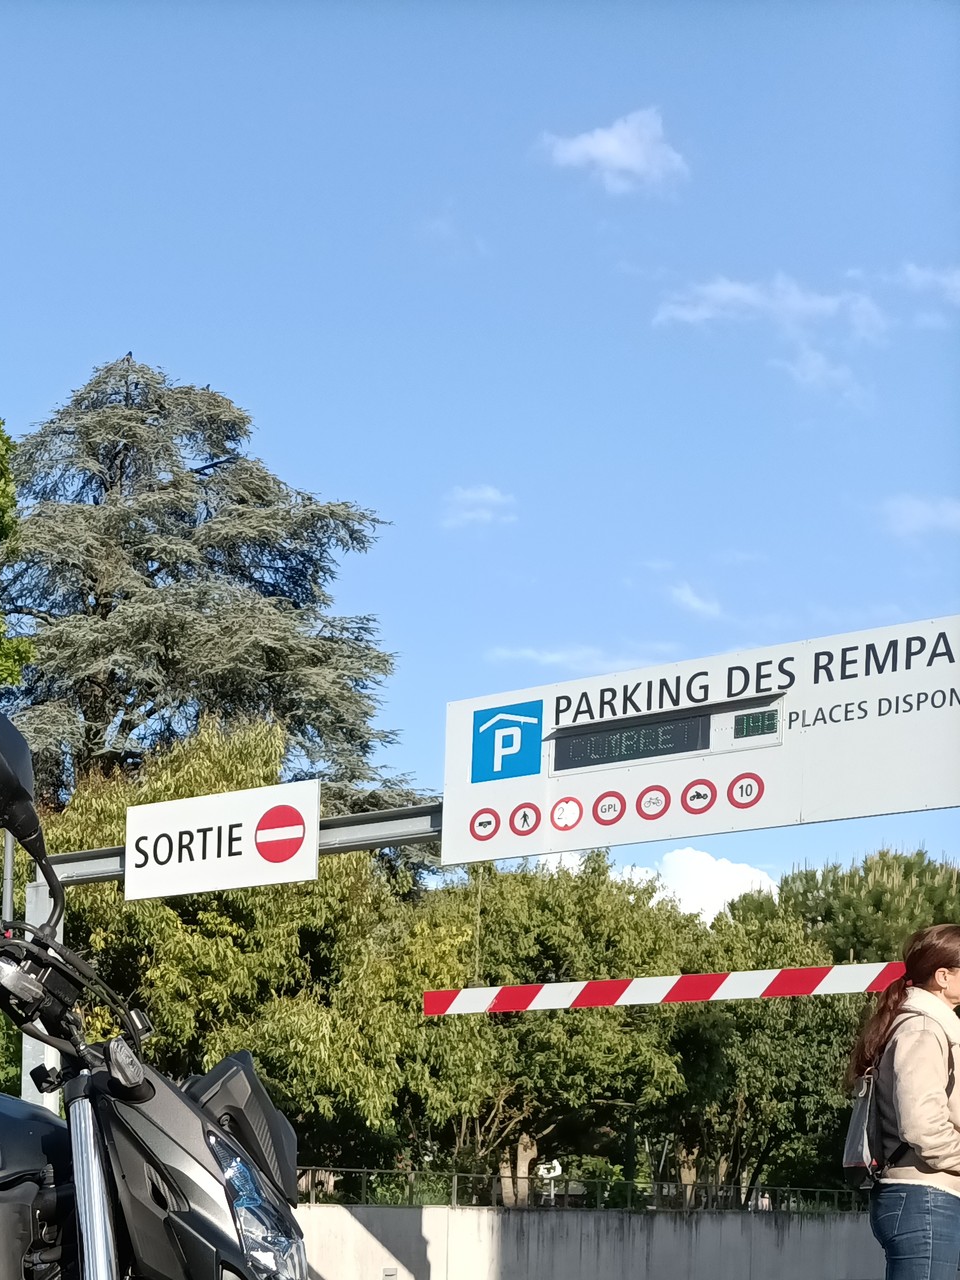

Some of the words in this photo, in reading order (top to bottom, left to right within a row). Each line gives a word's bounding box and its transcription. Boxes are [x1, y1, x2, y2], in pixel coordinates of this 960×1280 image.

[555, 671, 709, 725] PARKING
[727, 657, 796, 698] DES
[788, 700, 868, 729] PLACES
[738, 783, 753, 798] 10
[600, 803, 618, 814] GPL
[135, 823, 243, 868] SORTIE
